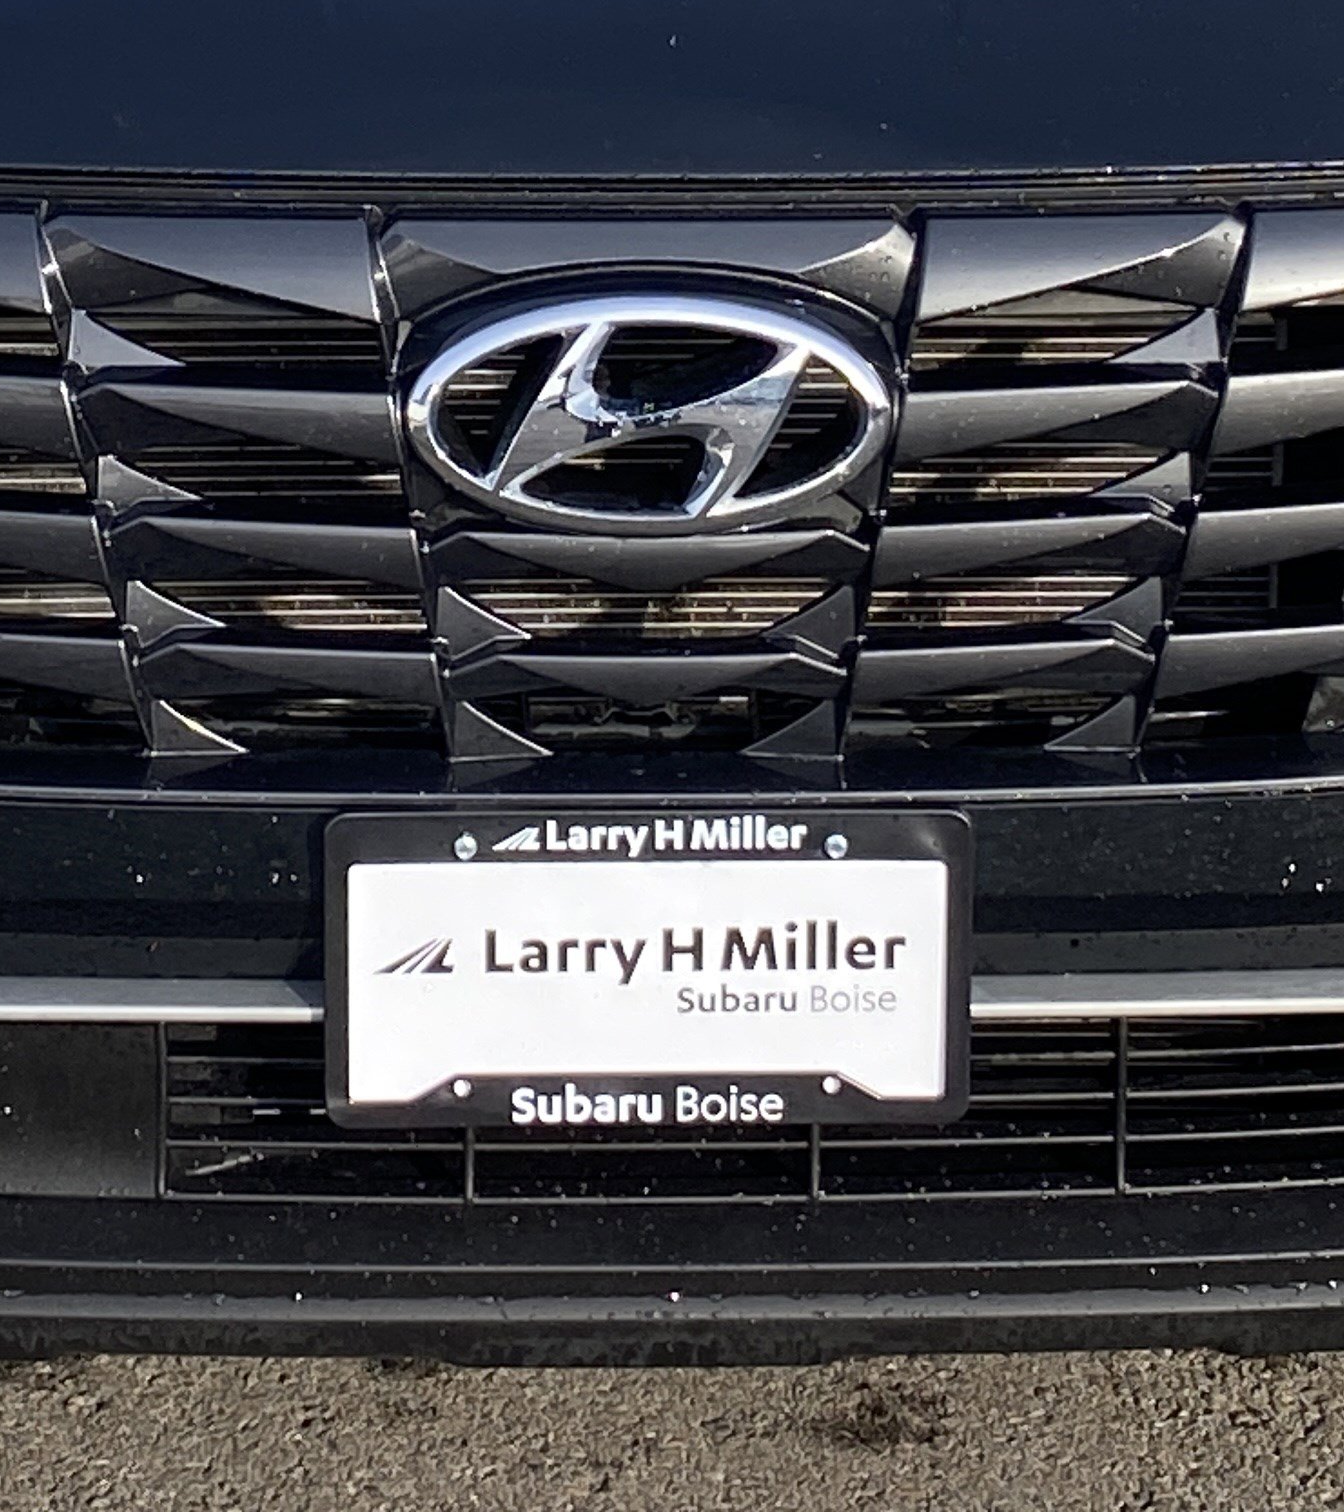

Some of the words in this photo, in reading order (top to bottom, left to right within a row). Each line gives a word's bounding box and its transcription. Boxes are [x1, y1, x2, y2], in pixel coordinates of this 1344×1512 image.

[546, 819, 650, 858] Larry
[654, 818, 685, 851] H
[689, 814, 808, 851] Miller
[485, 930, 647, 985] Larry
[662, 928, 705, 972] H
[720, 920, 907, 971] Miller
[676, 984, 799, 1014] Subaru
[809, 984, 898, 1013] Boise
[511, 1083, 663, 1125] Subaru
[676, 1084, 785, 1123] Boise
